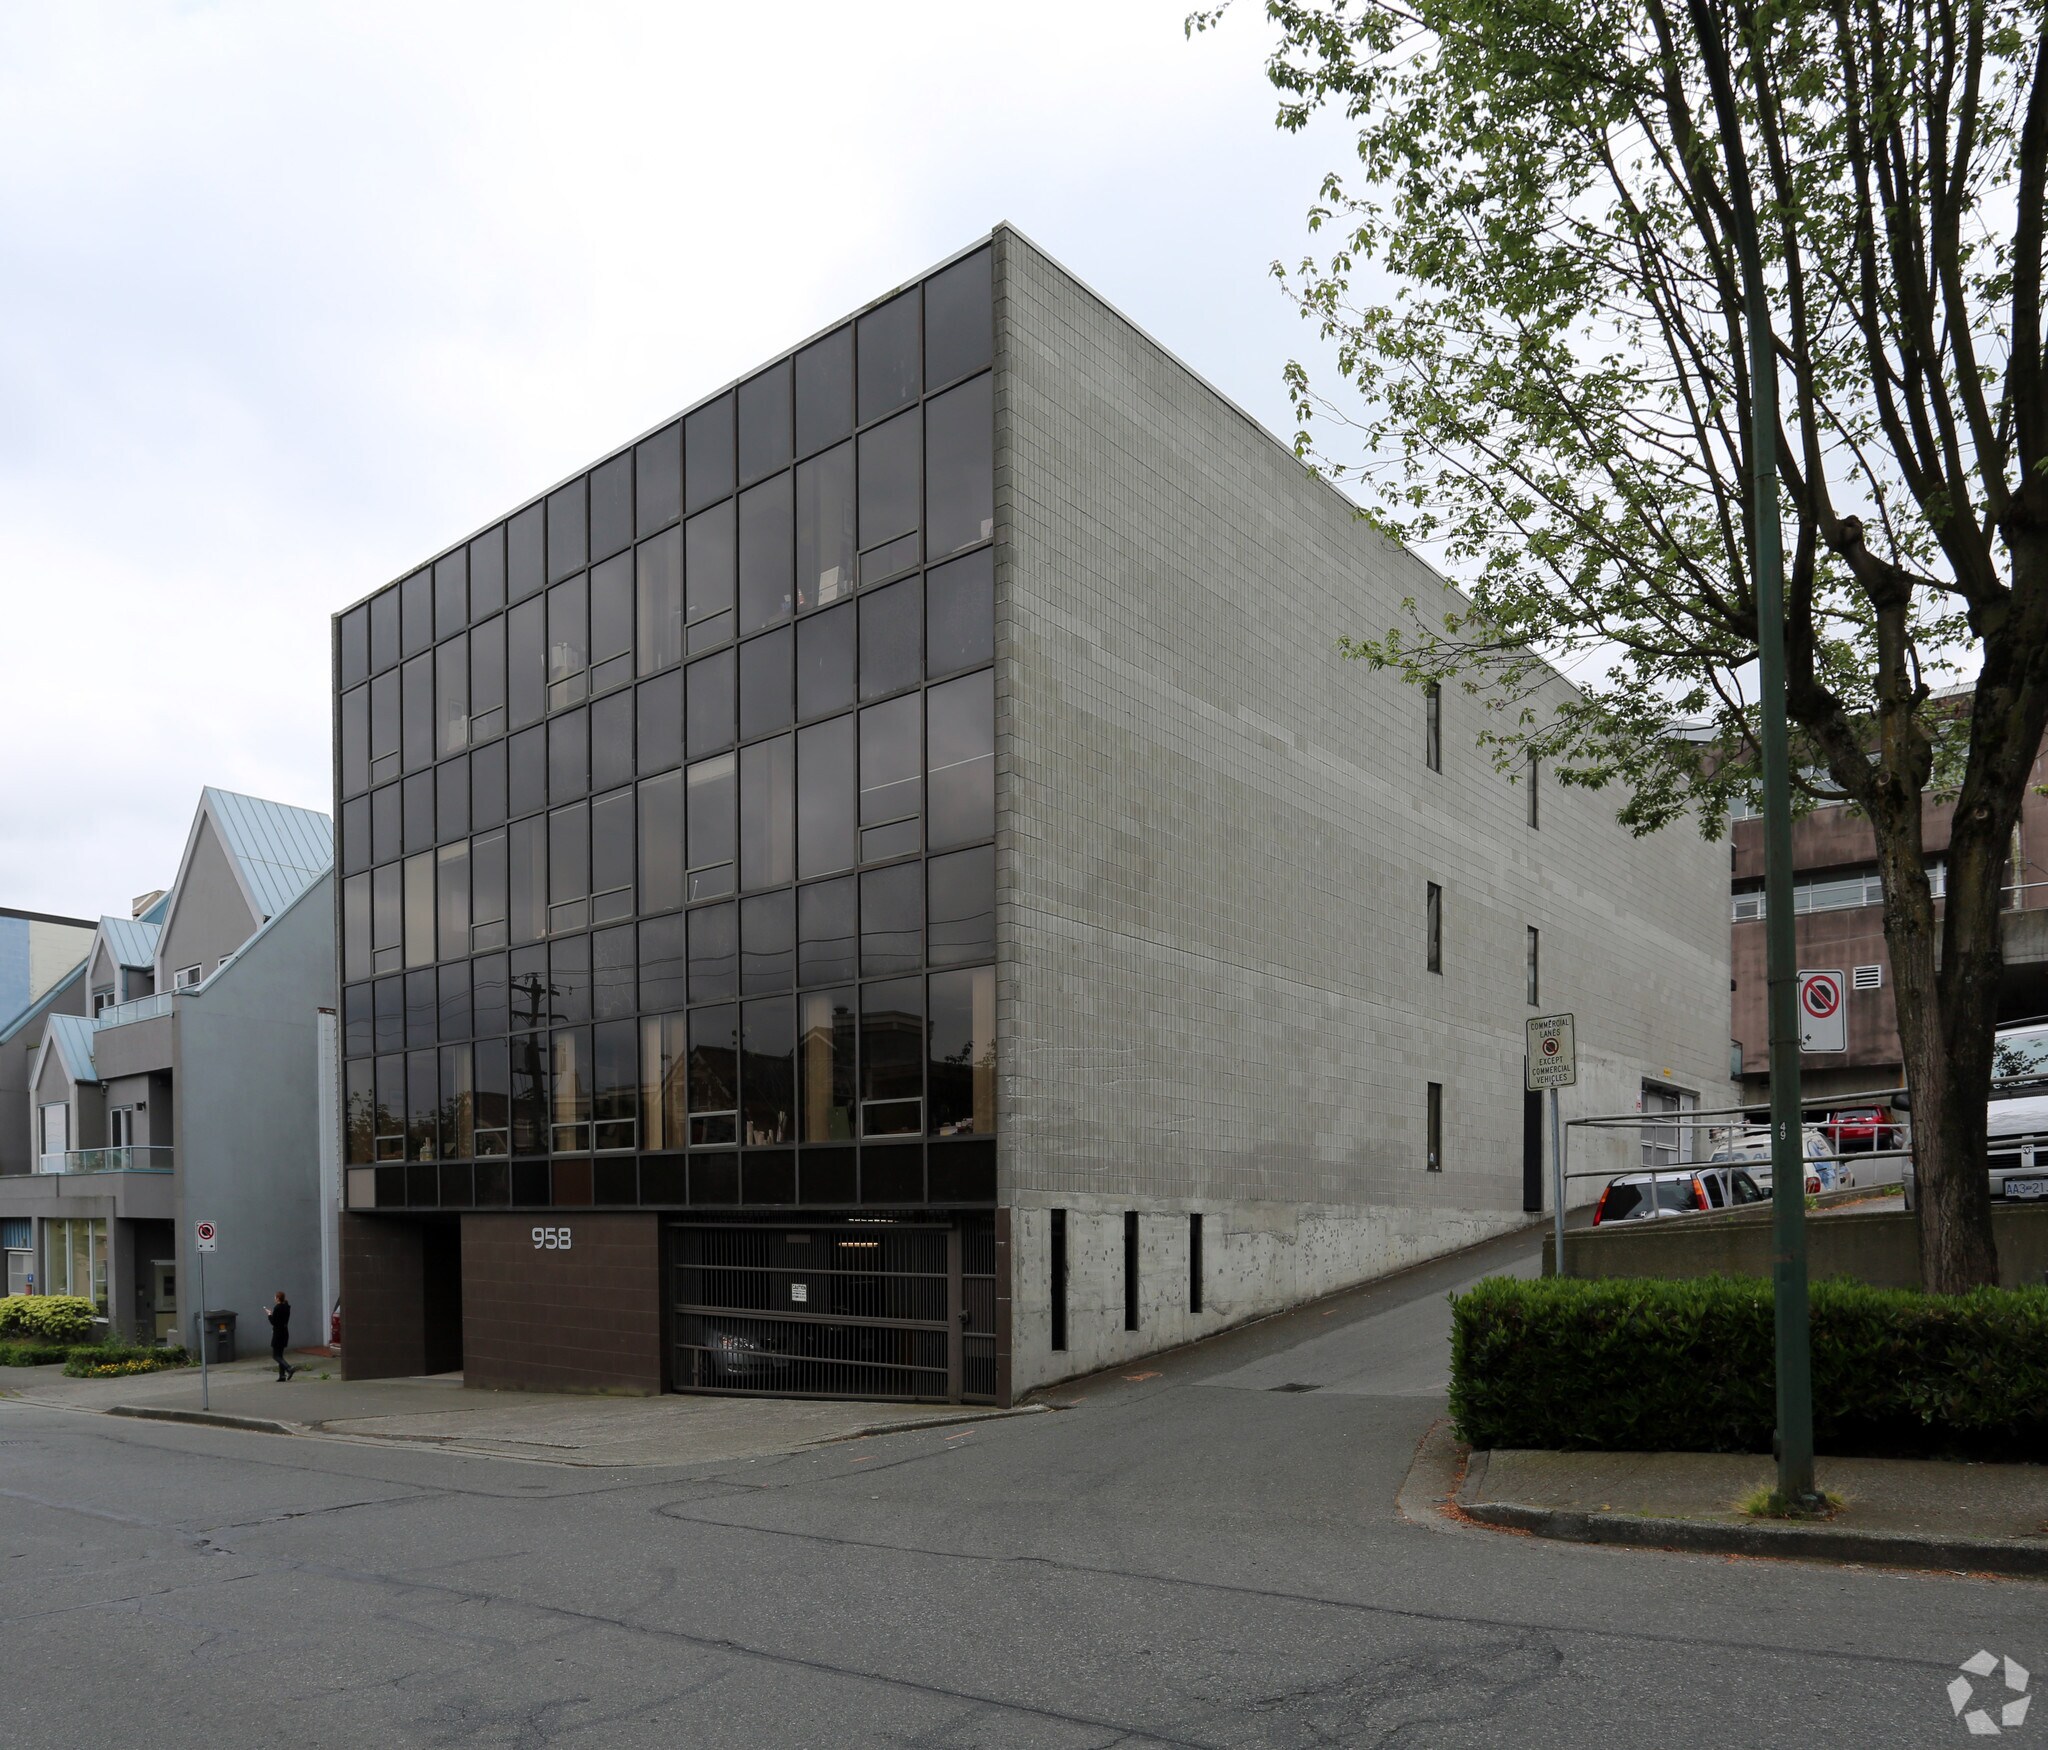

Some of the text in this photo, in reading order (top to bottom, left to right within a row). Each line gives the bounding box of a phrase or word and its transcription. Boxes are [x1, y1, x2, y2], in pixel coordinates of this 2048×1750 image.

[1531, 1019, 1569, 1030] COMMERCIAL
[1540, 1029, 1560, 1038] LANES
[1539, 1056, 1563, 1065] EXCEPT
[1532, 1064, 1571, 1075] COMMERCIAL
[1537, 1073, 1568, 1083] VEHICLES
[1780, 1121, 1786, 1140] 49
[532, 1227, 572, 1250] 958
